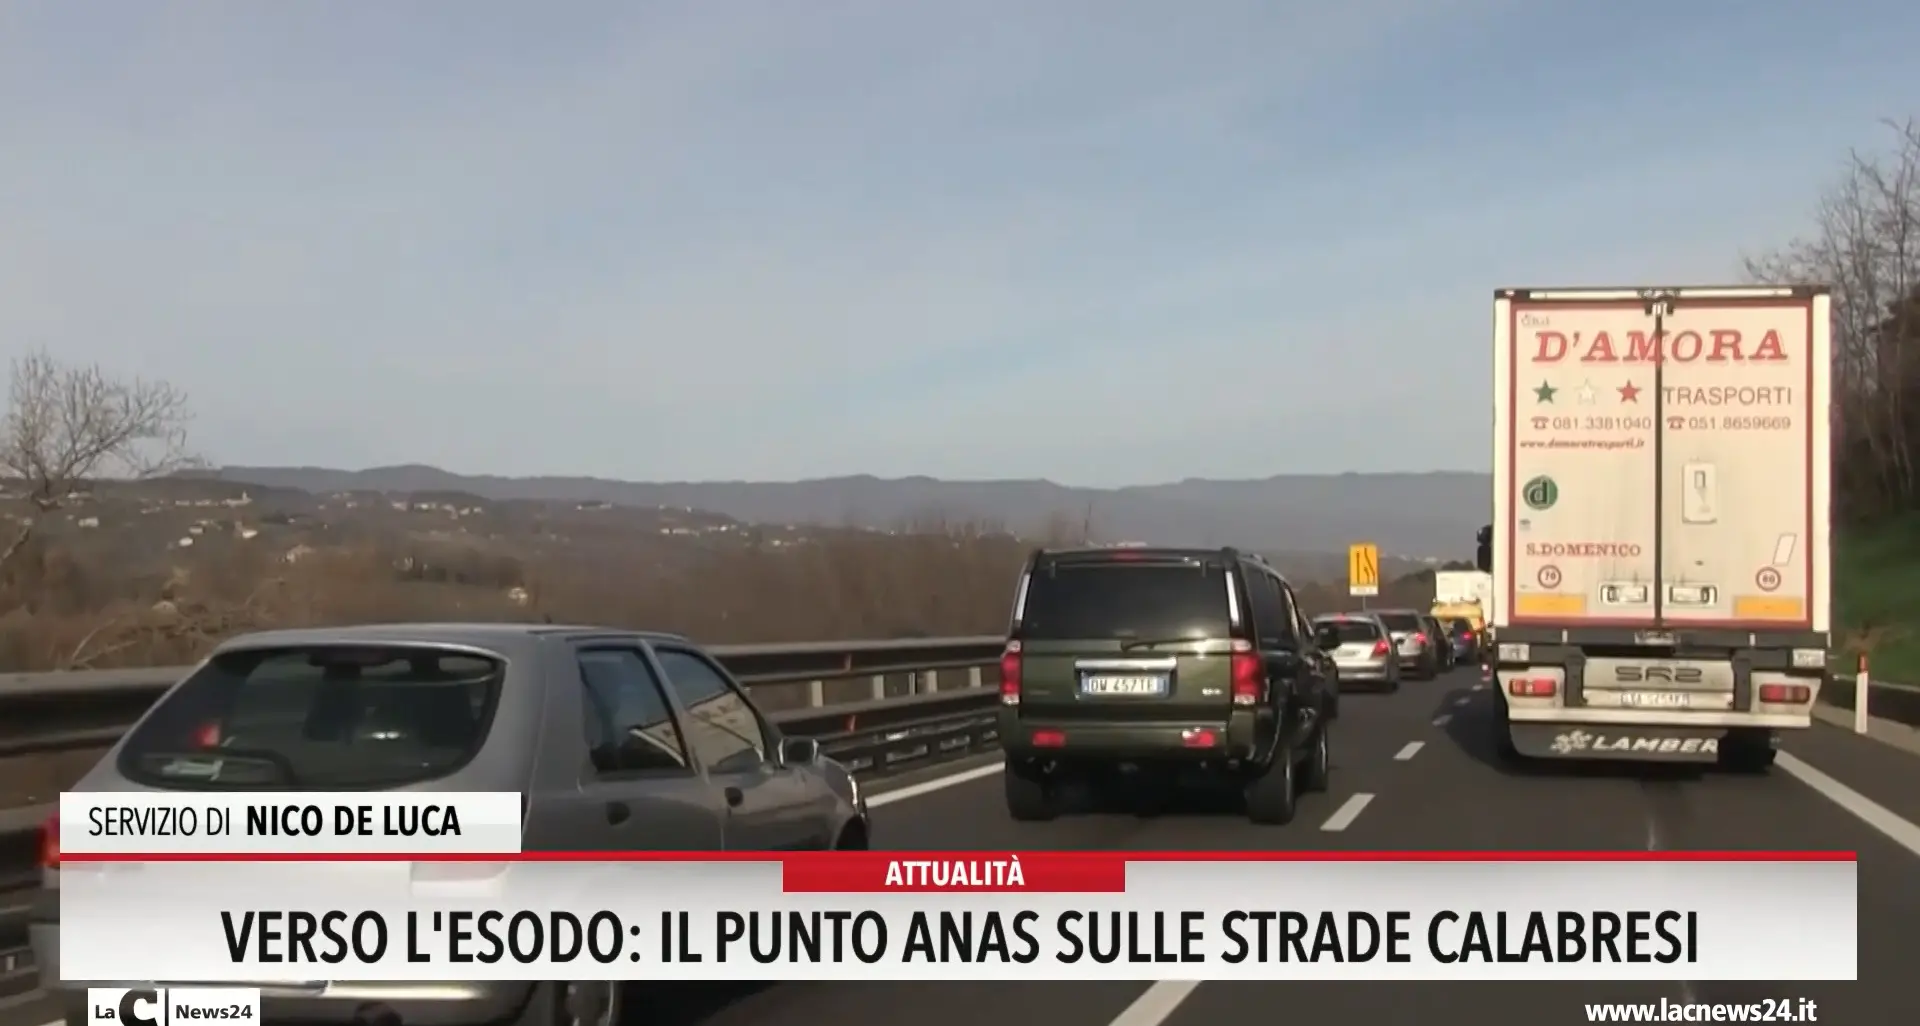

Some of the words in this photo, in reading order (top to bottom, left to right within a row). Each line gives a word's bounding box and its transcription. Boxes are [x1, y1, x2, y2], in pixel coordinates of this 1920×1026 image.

[1532, 328, 1788, 364] D'AMORA
[1662, 386, 1792, 405] TRASPORTI
[1526, 543, 1641, 557] S.DOMENICO
[1592, 735, 1718, 753] LAMBER
